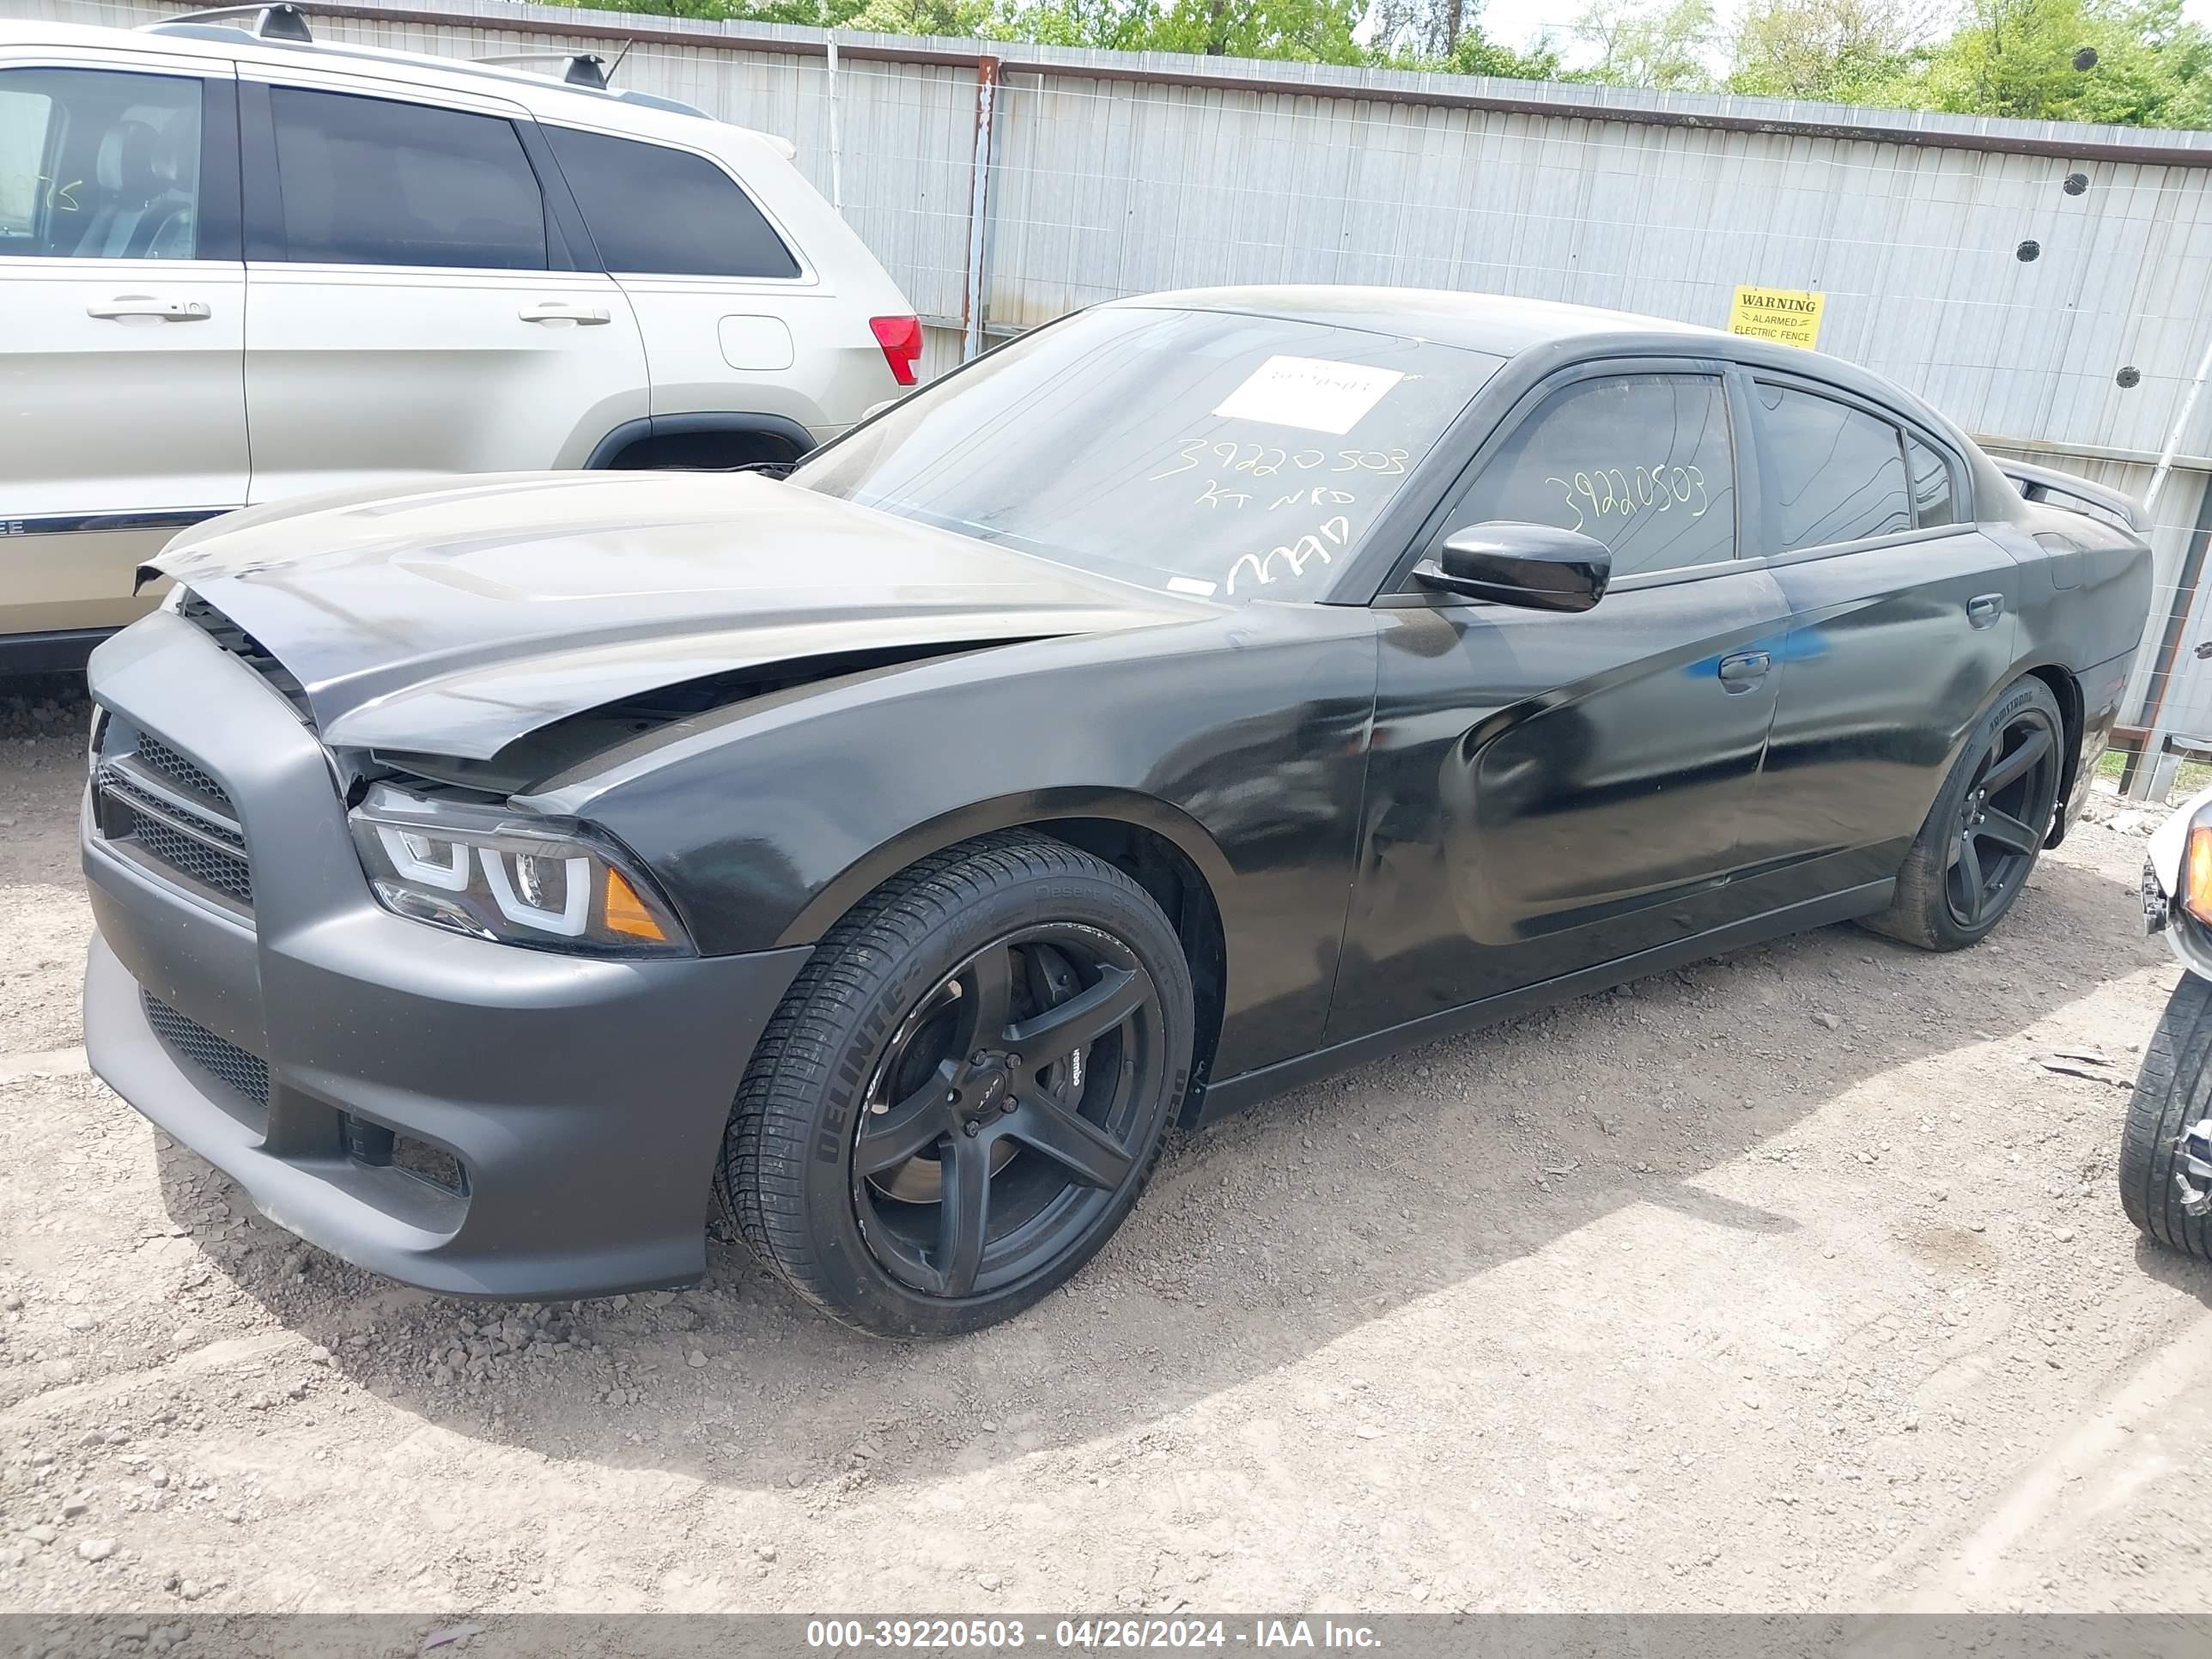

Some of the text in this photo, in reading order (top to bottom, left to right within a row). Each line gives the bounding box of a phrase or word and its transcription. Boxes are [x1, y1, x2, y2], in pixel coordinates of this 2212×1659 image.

[1741, 294, 1816, 312] WARNING
[1752, 314, 1798, 327] ALARMED
[1735, 325, 1811, 342] ELECTRIC FENCE
[1545, 464, 1708, 532] 39220503
[816, 977, 908, 1164] DELINTE
